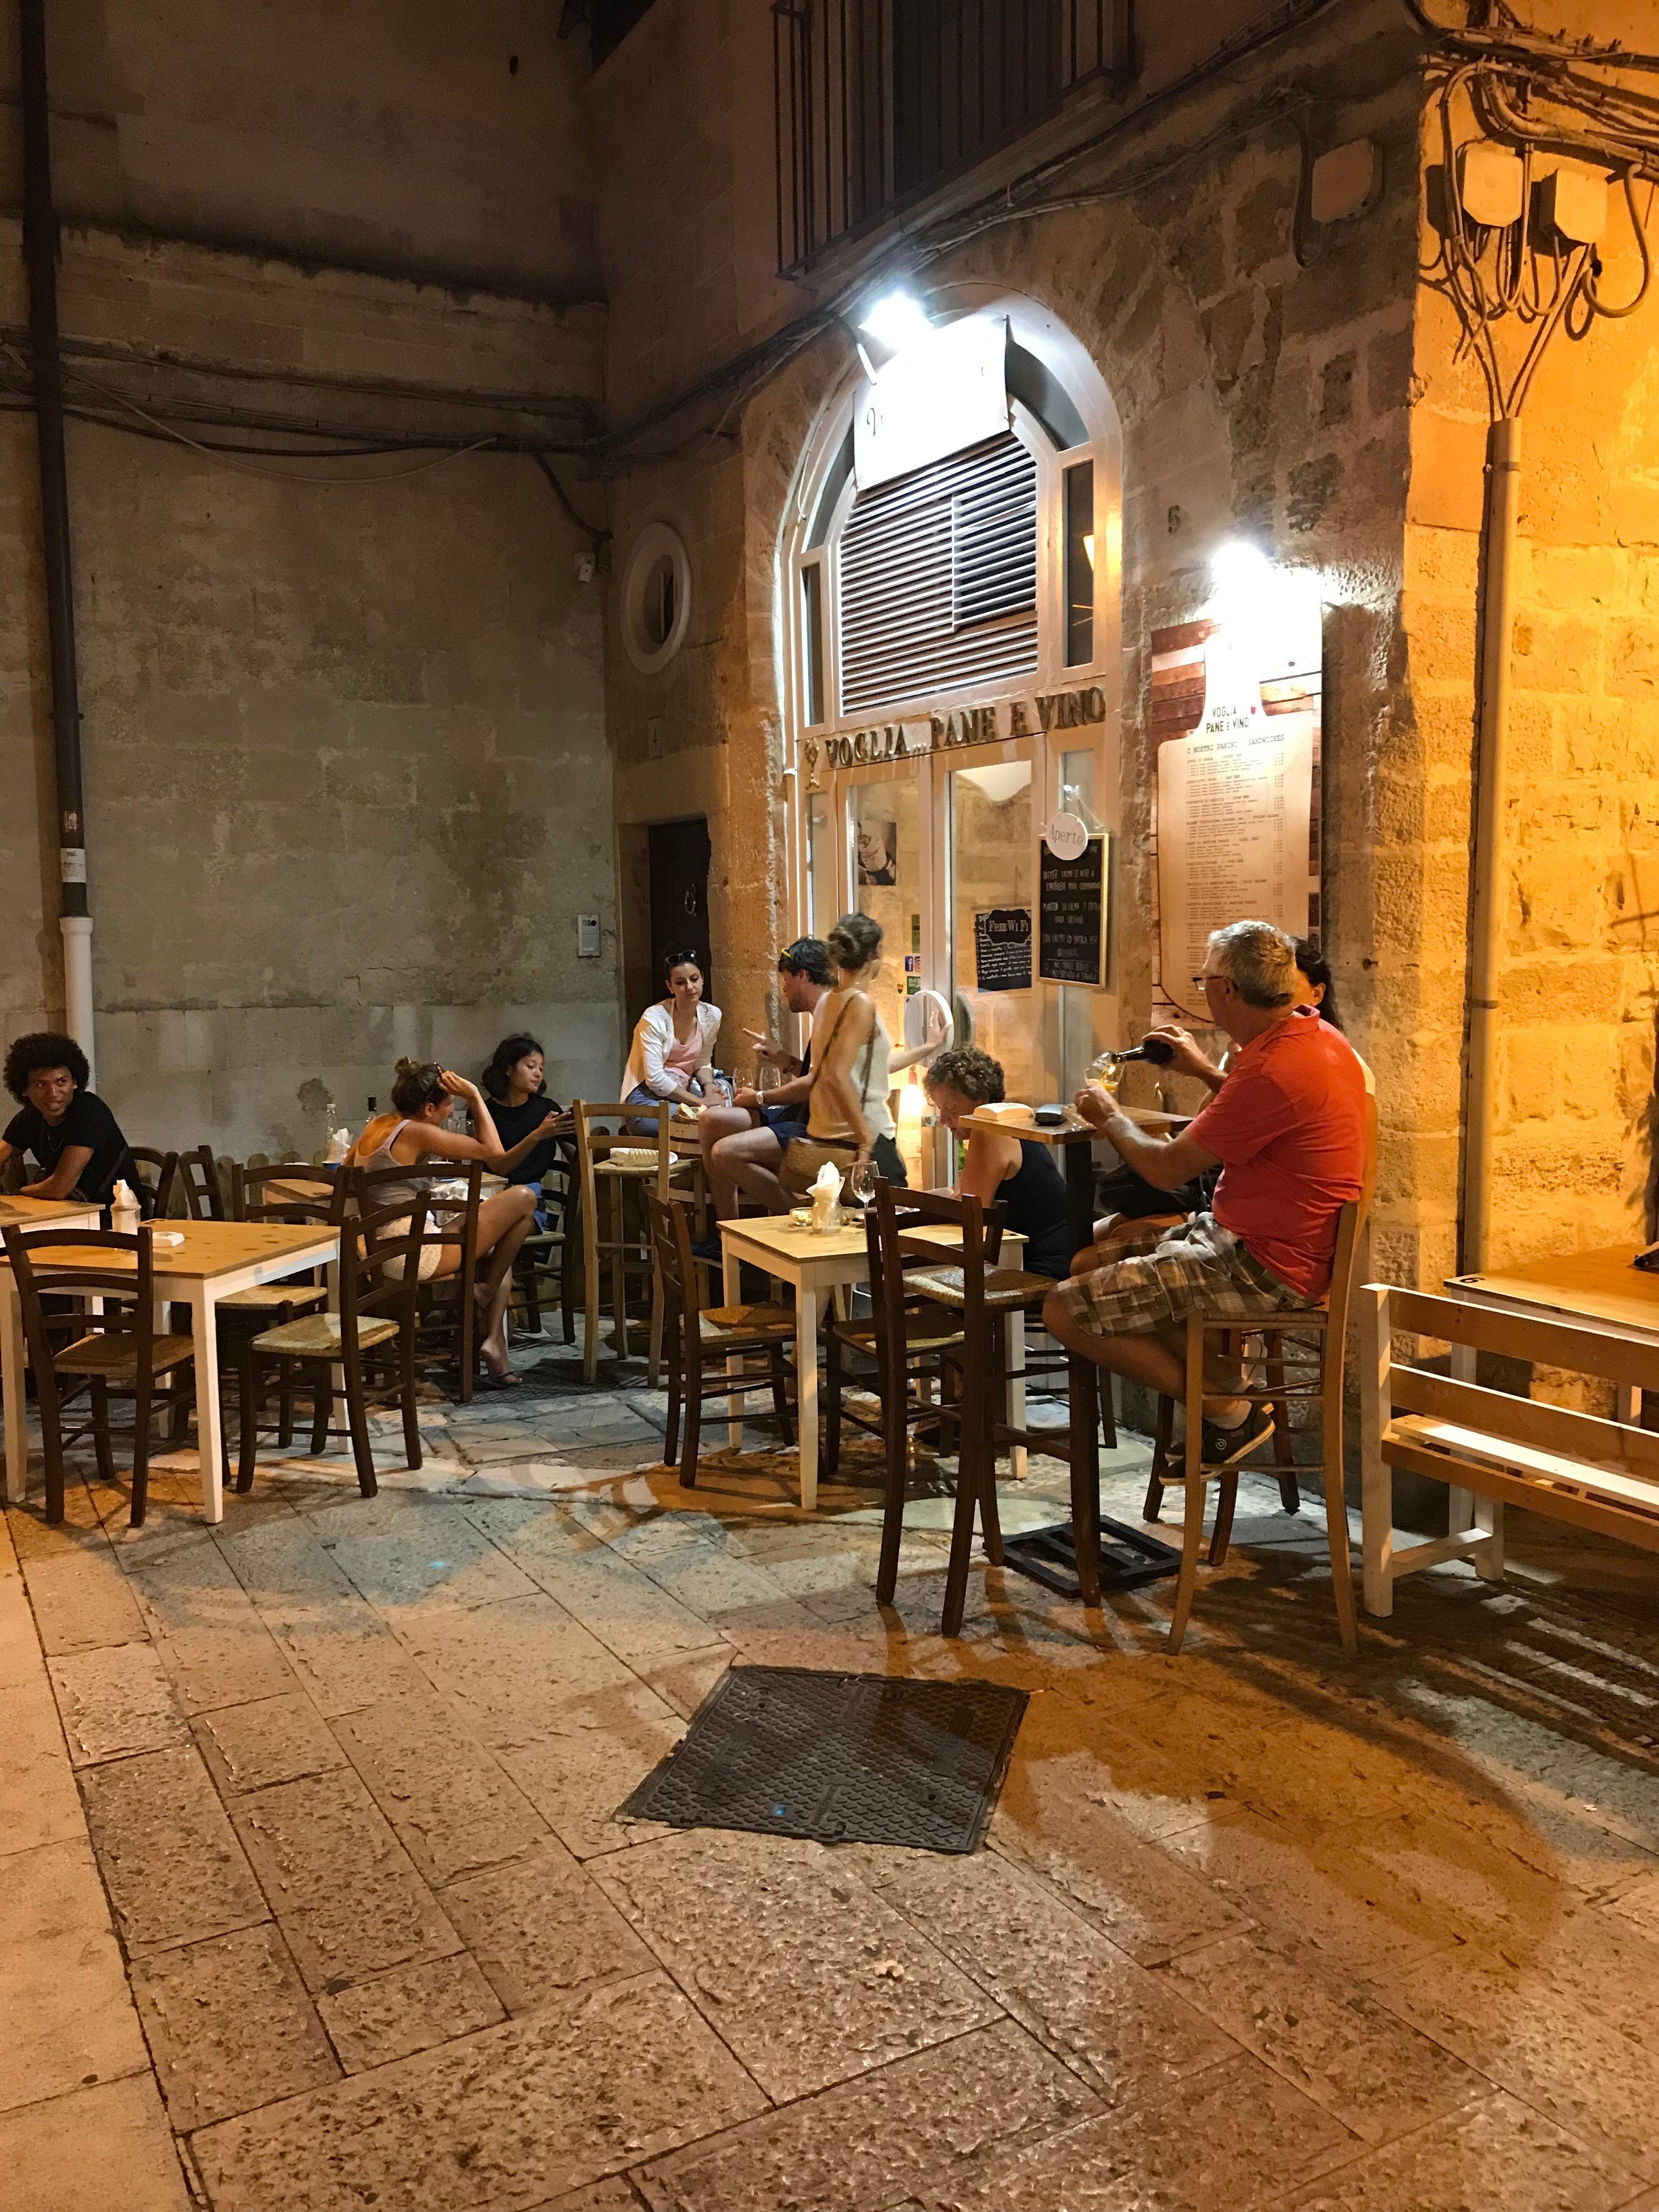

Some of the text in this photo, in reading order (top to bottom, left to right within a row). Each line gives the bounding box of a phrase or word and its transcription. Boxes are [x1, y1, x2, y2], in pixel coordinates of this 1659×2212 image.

[929, 707, 996, 749] PANE
[1009, 701, 1029, 736] E
[1035, 686, 1106, 731] VINO
[1212, 706, 1237, 718] VOGLIA
[1206, 720, 1224, 733] PANE
[1233, 717, 1249, 729] VINO
[1193, 744, 1214, 753] NOSTRI
[1217, 741, 1237, 750] PANINI
[1248, 734, 1284, 746] SANDWICHES
[1048, 824, 1084, 845] Aperto
